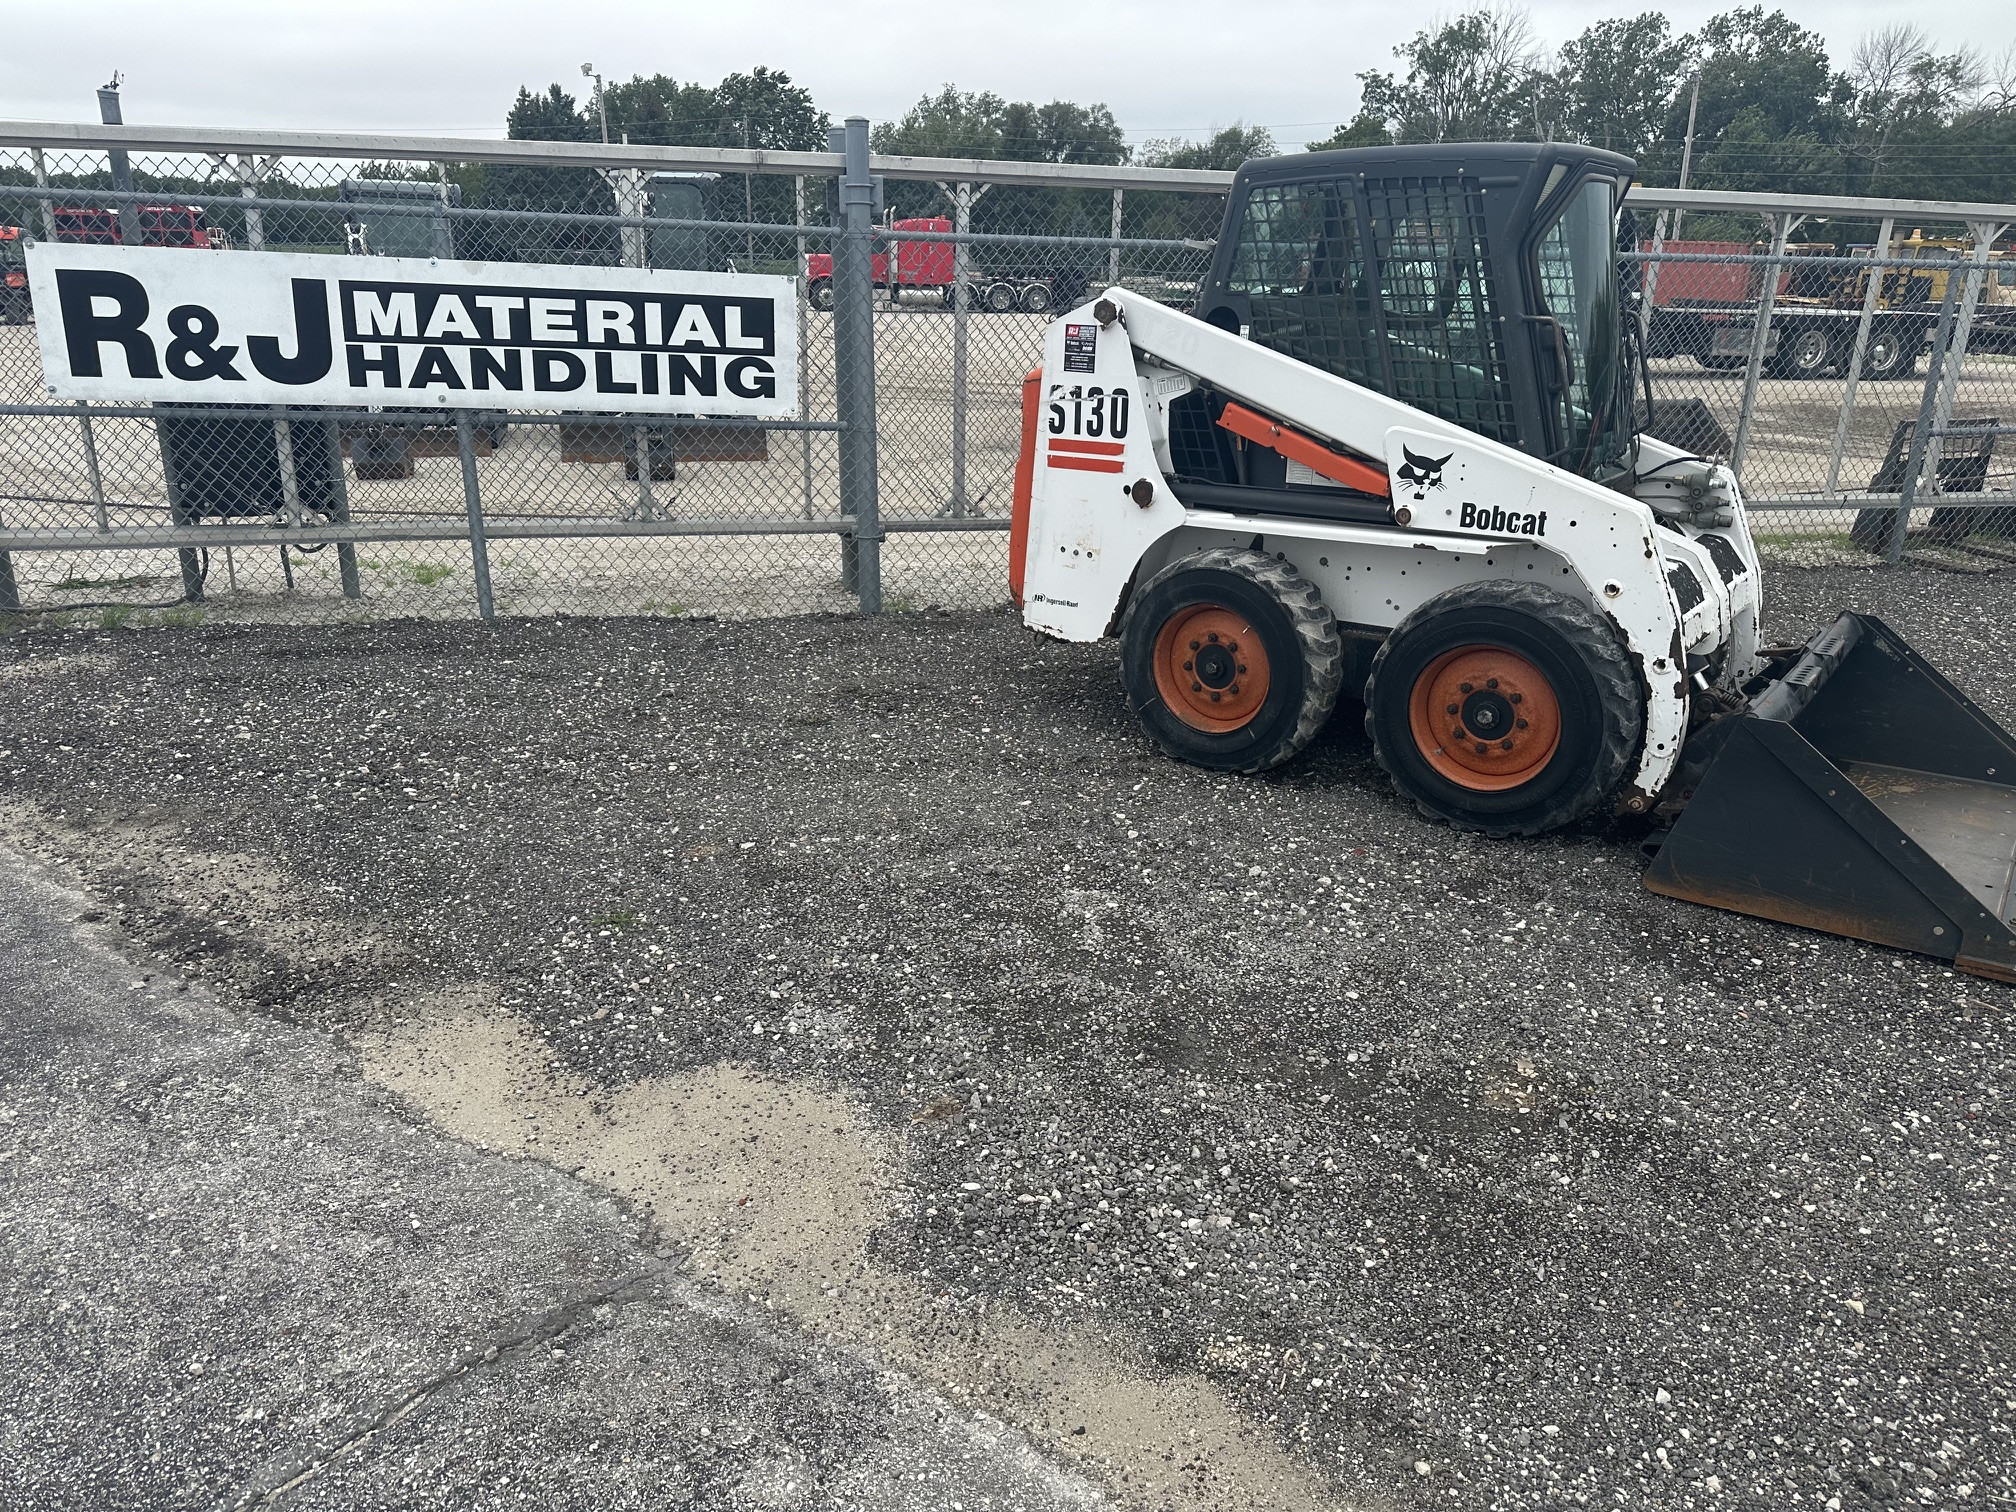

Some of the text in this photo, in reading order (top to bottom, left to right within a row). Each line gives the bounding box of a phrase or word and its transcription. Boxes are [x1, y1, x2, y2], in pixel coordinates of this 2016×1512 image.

[55, 268, 333, 386] R&J
[352, 290, 764, 350] MATERIAL
[345, 344, 776, 399] HANDLING
[1048, 384, 1129, 439] S130
[1459, 502, 1548, 537] Bobcat
